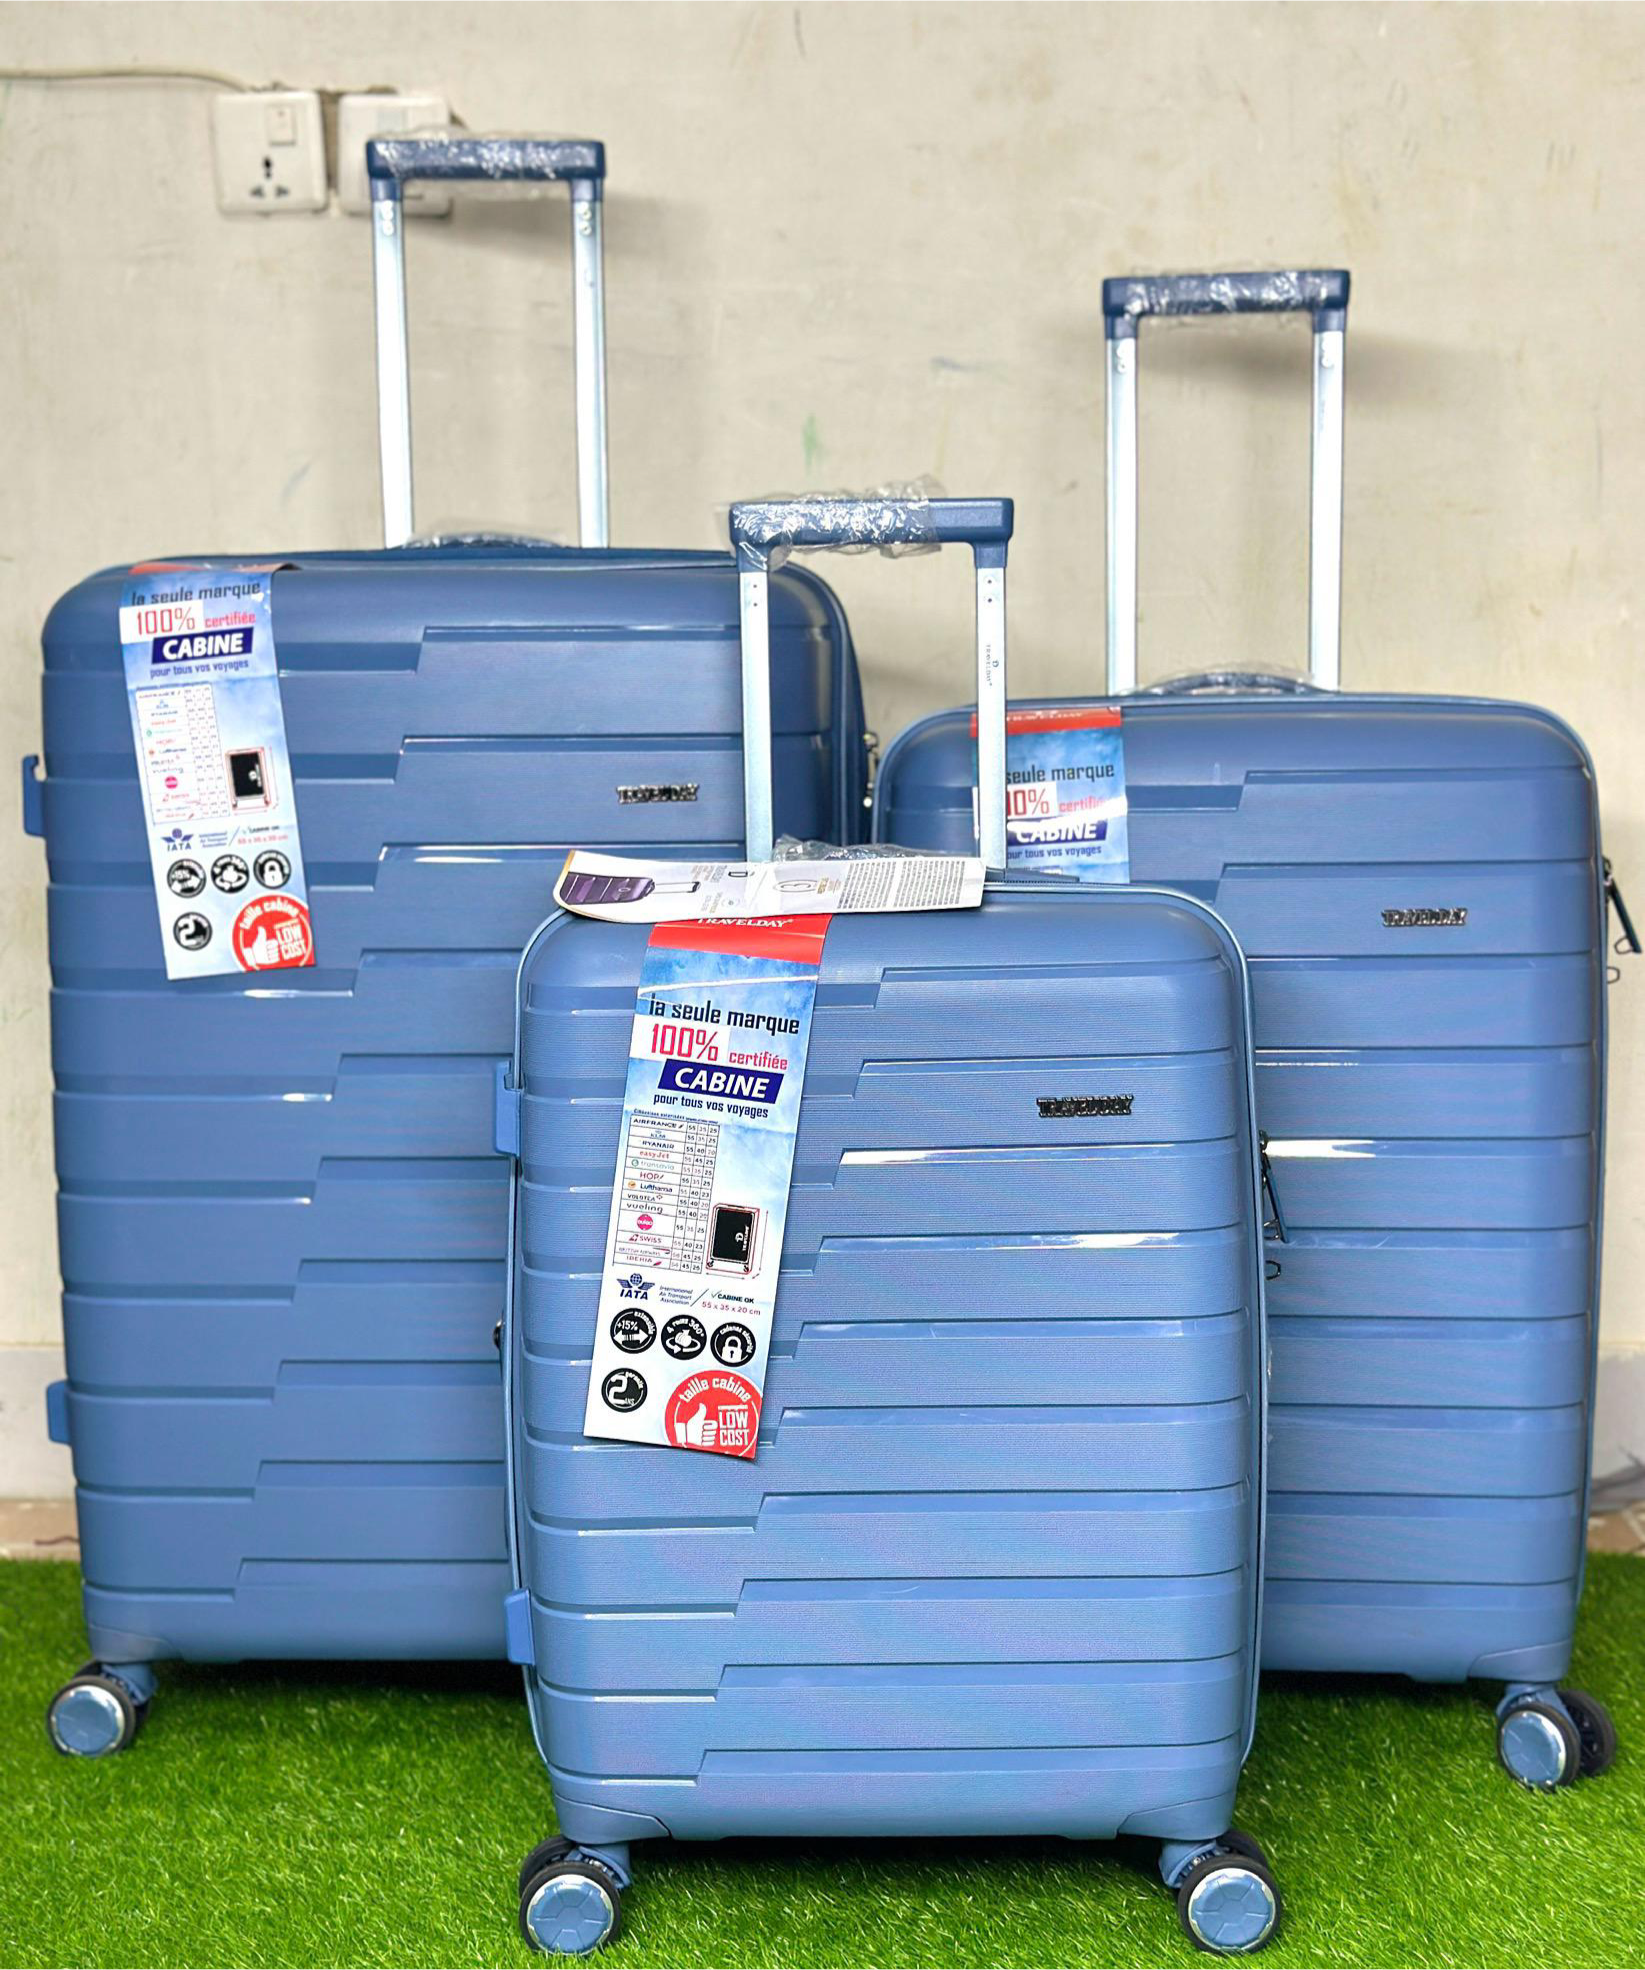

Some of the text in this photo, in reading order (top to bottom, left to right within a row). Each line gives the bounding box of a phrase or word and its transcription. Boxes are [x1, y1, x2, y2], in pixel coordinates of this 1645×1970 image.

[132, 581, 261, 607] la seule marque
[137, 606, 257, 636] 100% certifiée
[162, 633, 244, 661] CABINE
[150, 659, 249, 680] pour tous vos voyages
[1006, 764, 1115, 784] seule marque
[167, 842, 192, 852] IATA
[1007, 845, 1102, 860] our tous vos voyages
[275, 923, 302, 944] LOW
[280, 940, 306, 960] COST
[650, 992, 800, 1037] la seule marque
[651, 1023, 788, 1071] 100% certifiée
[674, 1067, 770, 1099] CABINE
[653, 1094, 679, 1105] pour
[681, 1096, 703, 1109] tous
[706, 1101, 724, 1112] vos
[727, 1104, 769, 1120] voyages
[633, 1117, 677, 1129] AIRFRANCE
[642, 1140, 675, 1149] RYANAIR
[639, 1150, 670, 1159] easyJet
[640, 1183, 673, 1193] Lufthansa
[626, 1203, 663, 1215] vueling
[619, 1288, 649, 1301] IATA
[659, 1285, 694, 1294] International
[667, 1292, 692, 1301] Transport
[717, 1293, 742, 1303] CABINE
[660, 1297, 690, 1306] Association
[702, 1301, 711, 1309] 55
[738, 1306, 748, 1314] 20
[749, 1308, 761, 1316] cm
[617, 1319, 639, 1331] +15%
[666, 1326, 674, 1334] 4
[688, 1319, 705, 1337] 360°
[608, 1373, 628, 1405] 2
[679, 1376, 752, 1403] taille cabine
[718, 1410, 748, 1429] LOW
[719, 1428, 749, 1446] COST
